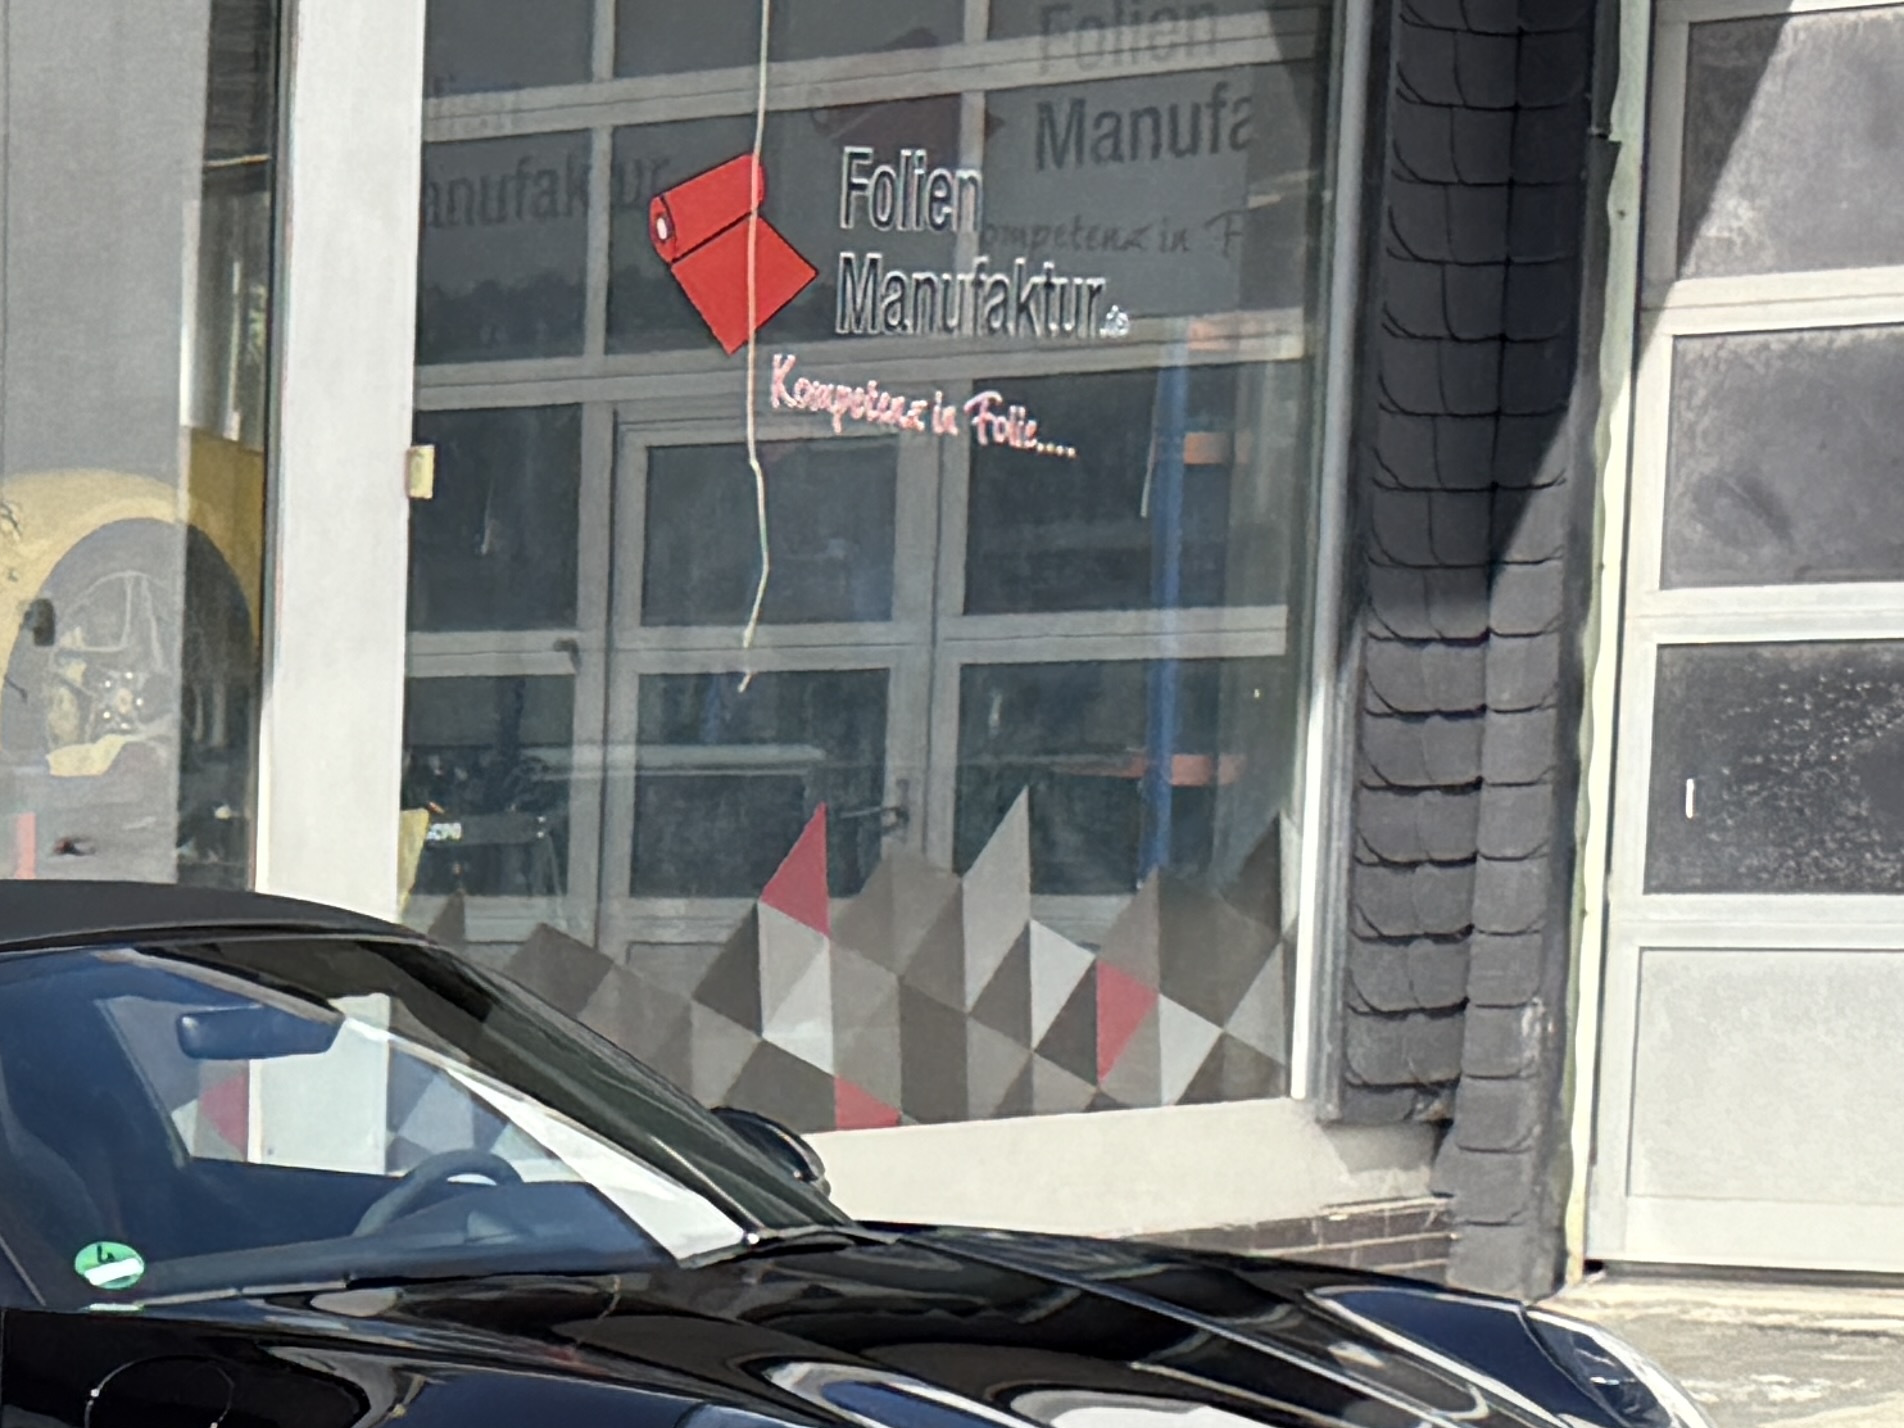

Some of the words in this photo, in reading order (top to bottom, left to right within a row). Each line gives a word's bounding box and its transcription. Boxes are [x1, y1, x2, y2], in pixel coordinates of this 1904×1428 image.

[841, 147, 983, 232] Folien
[771, 353, 929, 435] Kompetenz
[932, 390, 959, 436] in
